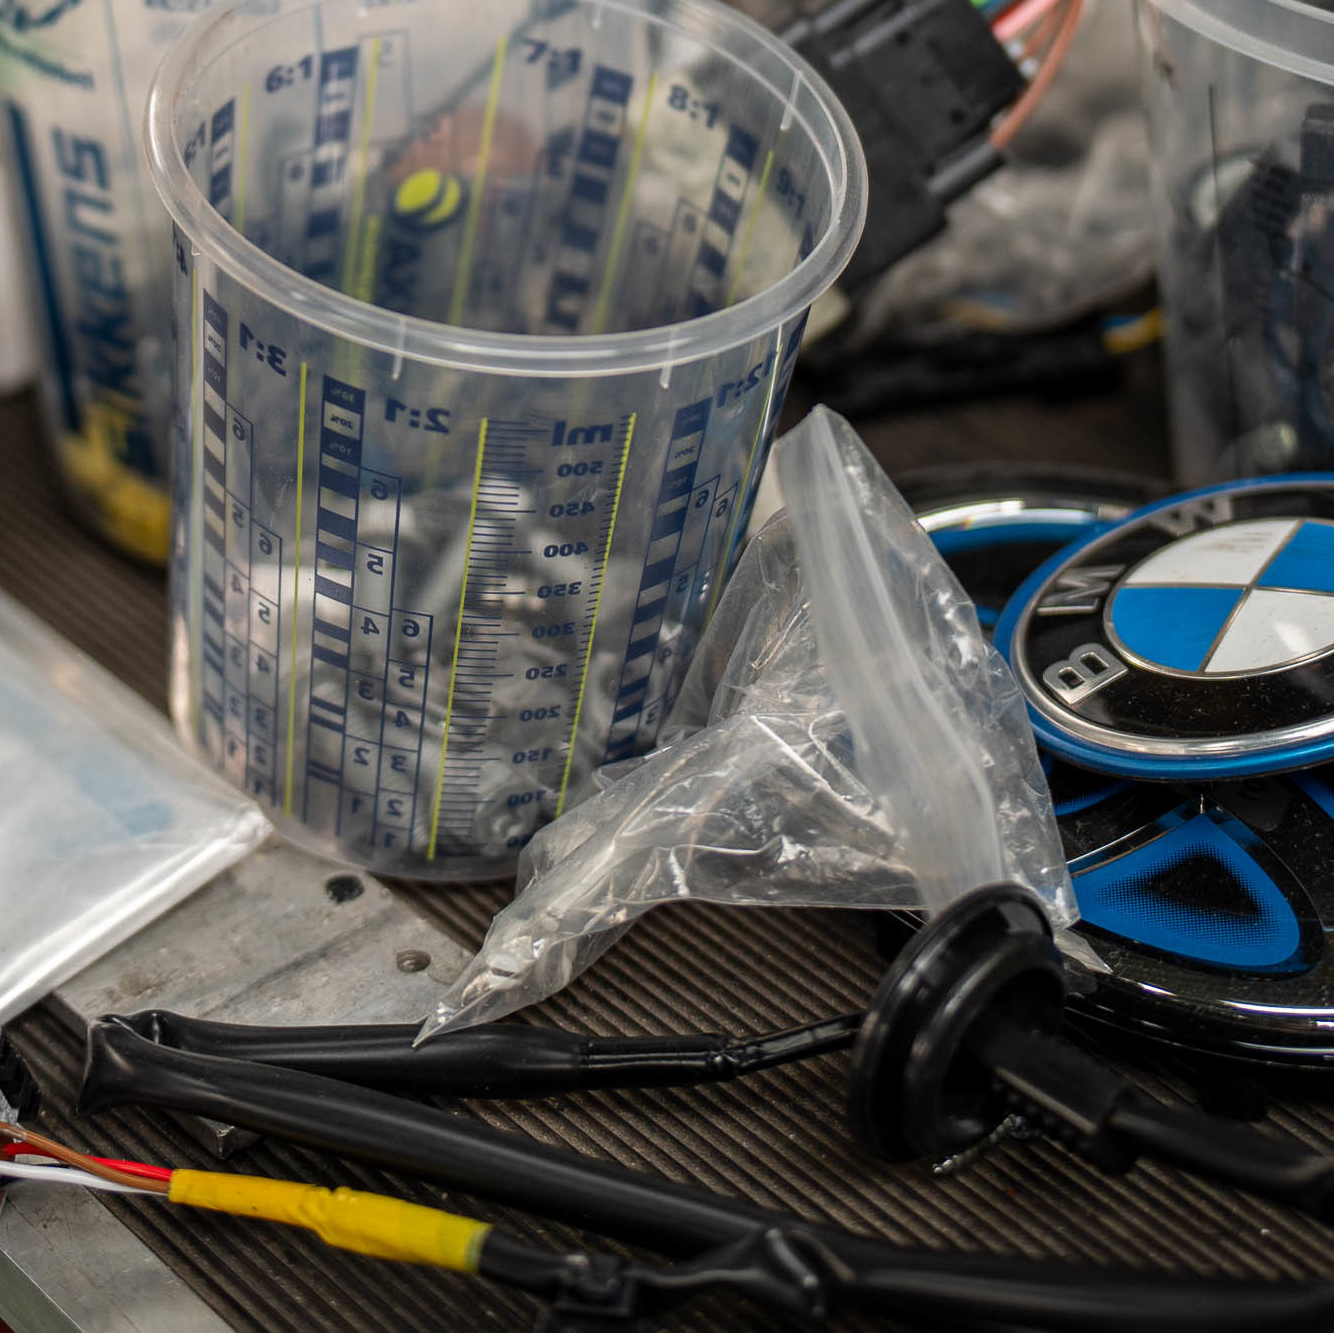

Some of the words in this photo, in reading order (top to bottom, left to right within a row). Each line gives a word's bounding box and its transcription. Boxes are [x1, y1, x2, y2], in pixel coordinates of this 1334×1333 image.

[266, 54, 313, 94] 6:1
[669, 84, 720, 129] 8:1
[1035, 496, 1233, 706] BMW
